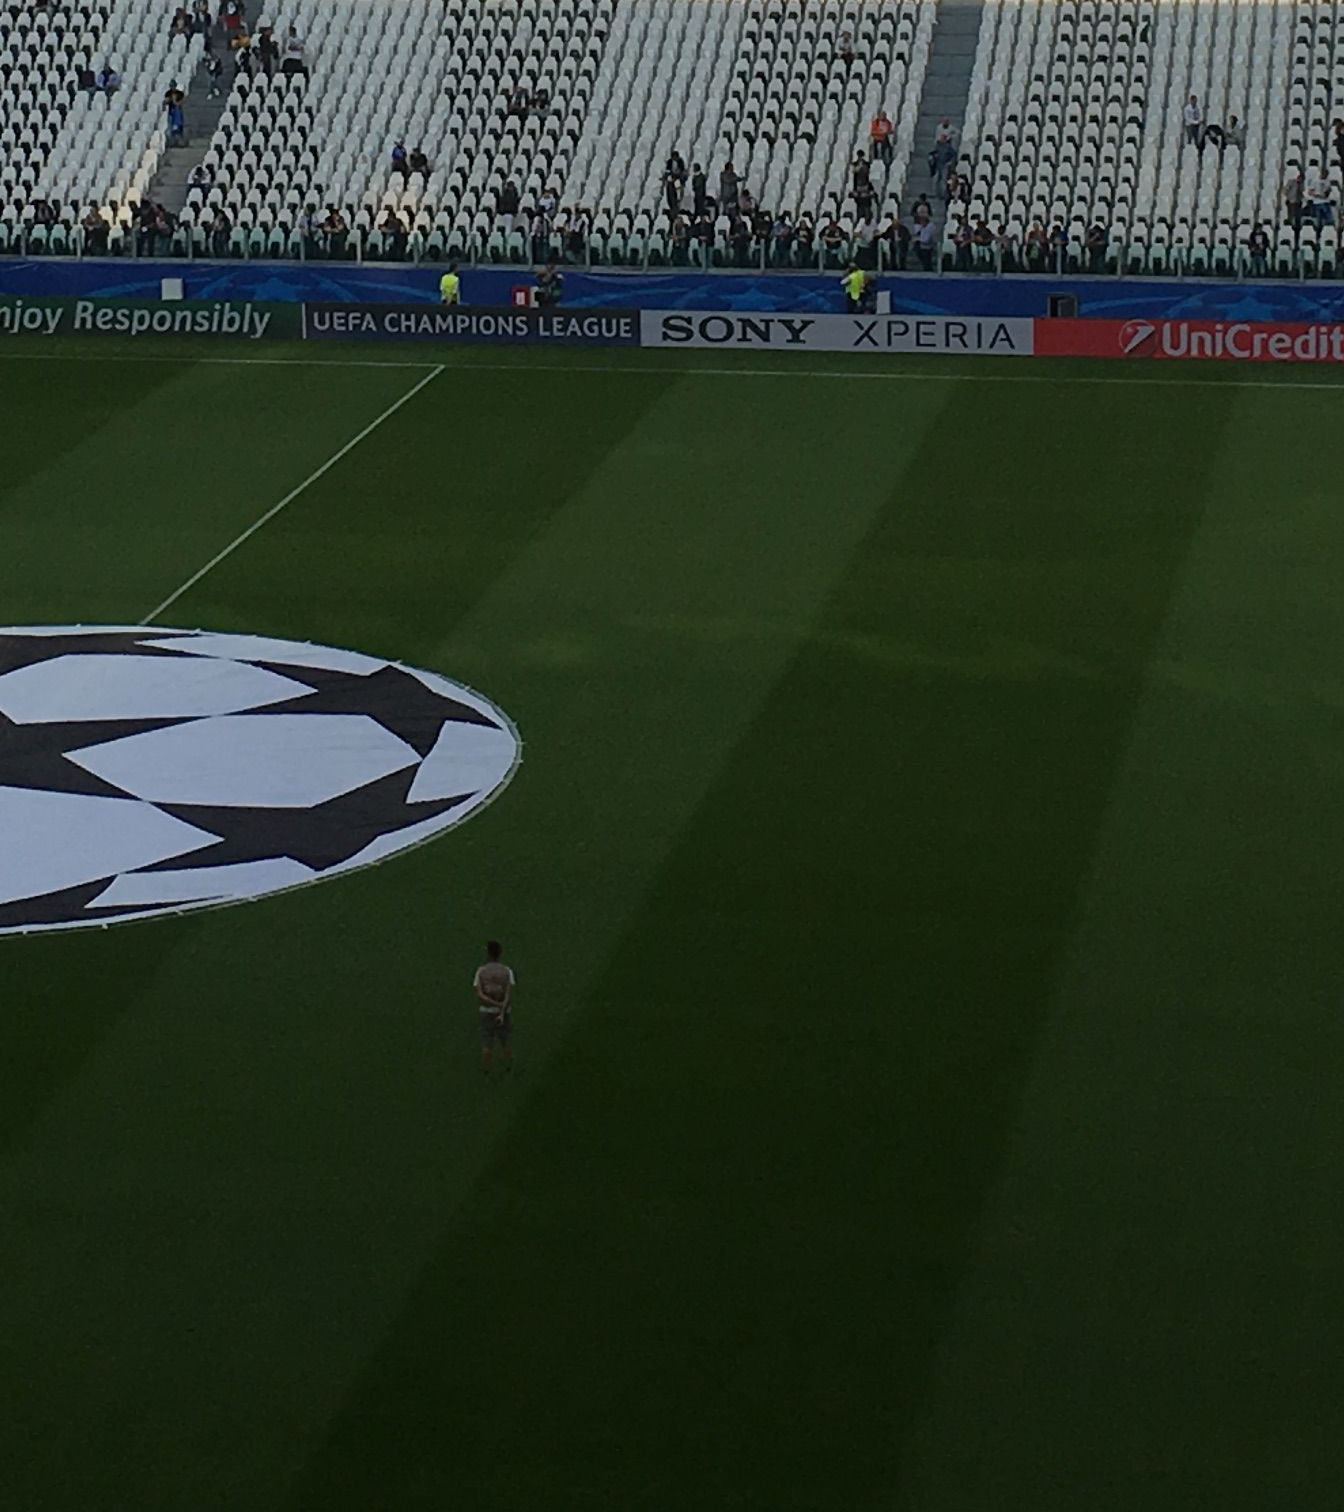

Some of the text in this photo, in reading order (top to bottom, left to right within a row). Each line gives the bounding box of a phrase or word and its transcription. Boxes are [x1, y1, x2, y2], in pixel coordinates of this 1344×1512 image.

[74, 300, 271, 339] Responsibly
[313, 311, 633, 338] UEFA CHAMPIONS LEAGUE
[661, 315, 1015, 349] SONY XPERIA
[1162, 322, 1344, 360] UniCredit
